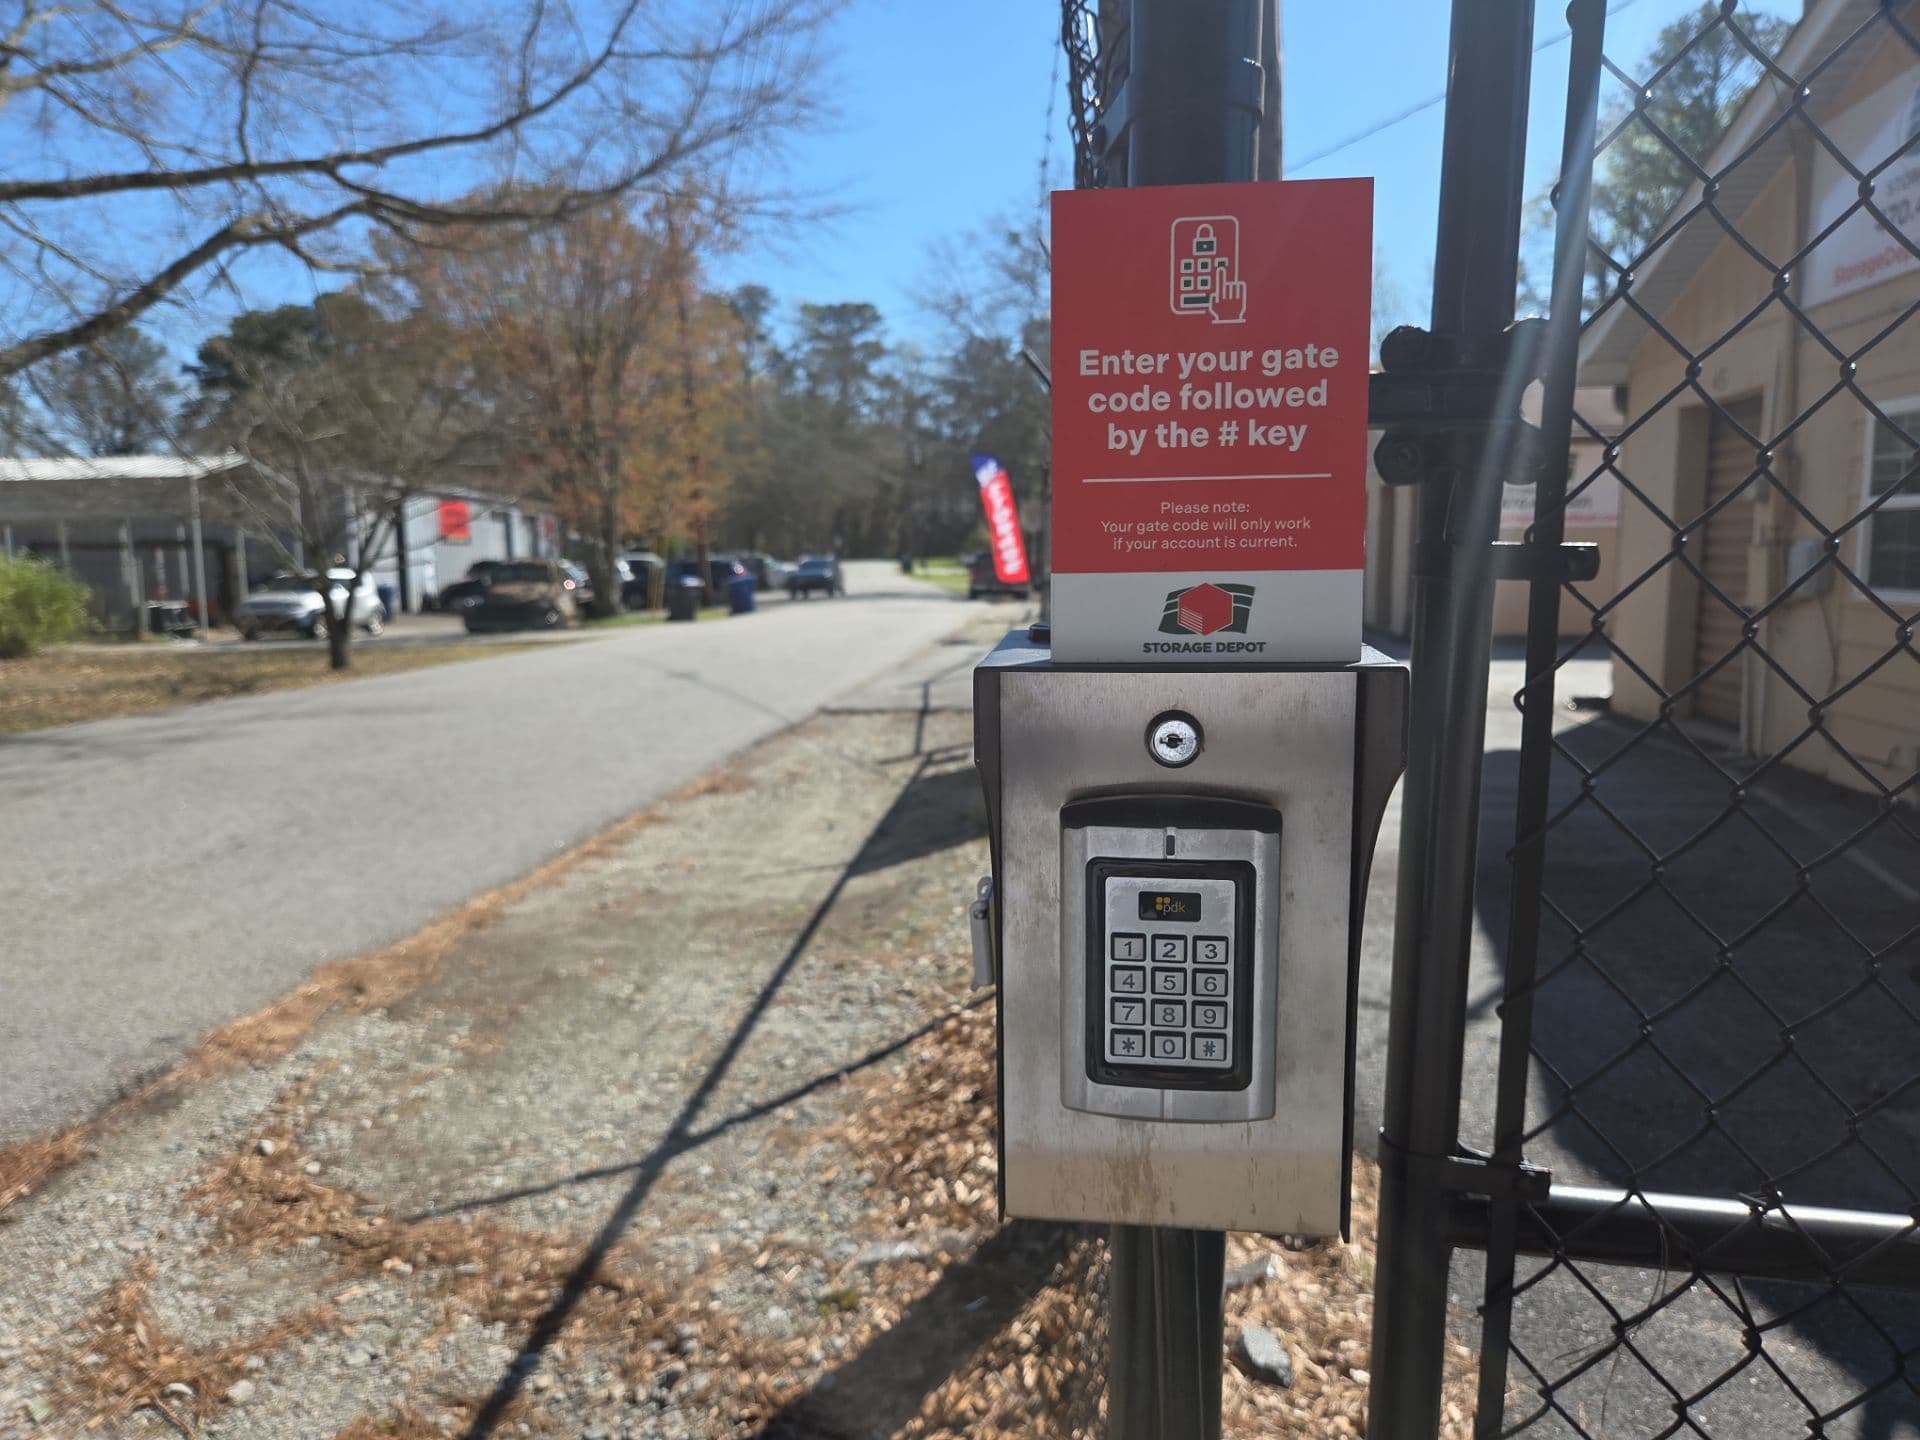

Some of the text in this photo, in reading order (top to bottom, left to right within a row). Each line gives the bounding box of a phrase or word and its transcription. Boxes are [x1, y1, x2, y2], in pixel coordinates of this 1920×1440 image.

[1079, 343, 1339, 379] Enter your gate
[1088, 379, 1328, 413] code followed
[1107, 418, 1308, 456] by the # key
[1160, 501, 1250, 515] Please note:
[1100, 517, 1311, 534] Your gate code will only work
[1113, 535, 1298, 552] if your account is current.
[1142, 641, 1267, 655] STORAGE DEPOT
[1163, 901, 1186, 916] pdk
[1124, 940, 1218, 960] 1 2 3
[1122, 973, 1218, 992] 4 5 6
[1121, 1005, 1217, 1025] 7 8 9
[1162, 1039, 1176, 1055] 0
[1203, 1041, 1217, 1057] #
